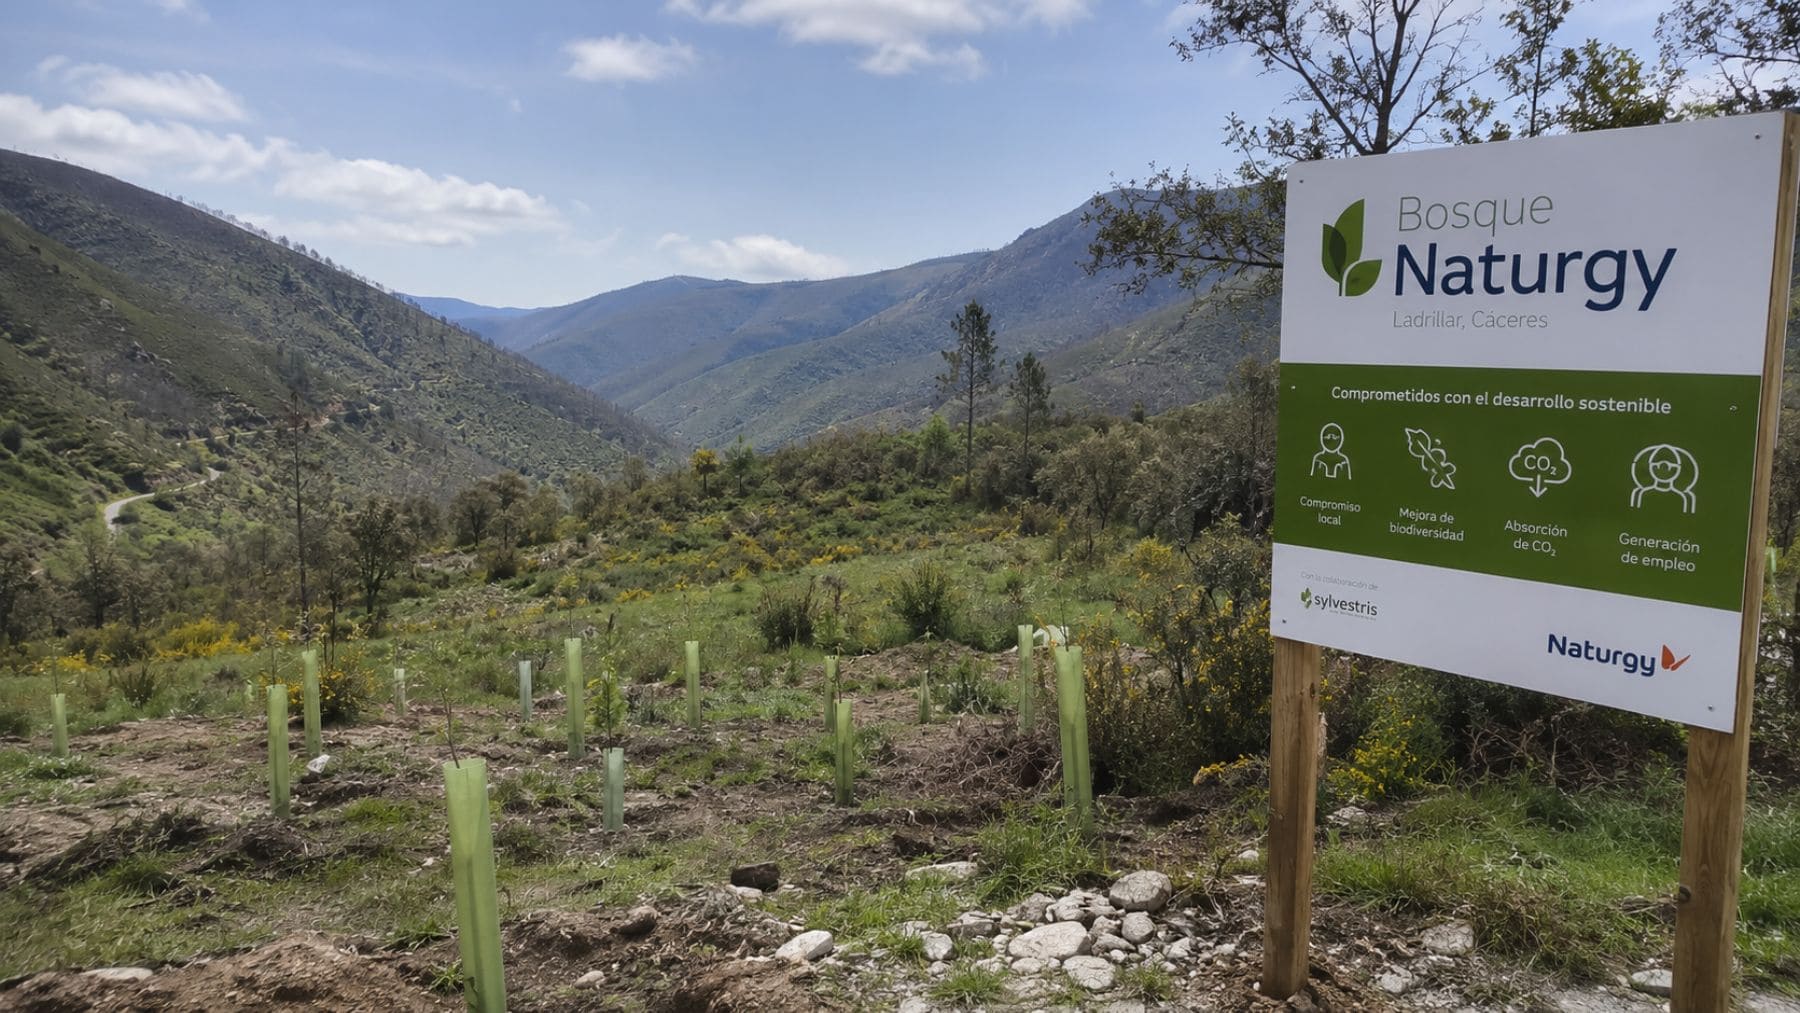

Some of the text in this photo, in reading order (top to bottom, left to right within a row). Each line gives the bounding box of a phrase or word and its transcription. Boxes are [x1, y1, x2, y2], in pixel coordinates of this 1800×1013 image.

[1399, 195, 1554, 238] Bosque
[1395, 242, 1678, 312] Naturgy
[1393, 310, 1548, 330] Ladrillar, Cáceres
[1331, 386, 1672, 415] Comprometidos con el desarrollo sostenible
[1299, 496, 1361, 513] Compromiso
[1318, 513, 1342, 526] local
[1399, 507, 1455, 524] Mejora de
[1389, 522, 1465, 542] biodiversidad
[1504, 519, 1568, 537] Absorción
[1513, 537, 1529, 550] de
[1618, 532, 1700, 554] Generación
[1620, 551, 1696, 572] de empleo
[1314, 593, 1378, 616] sylvestris
[1547, 633, 1656, 678] Naturgy
